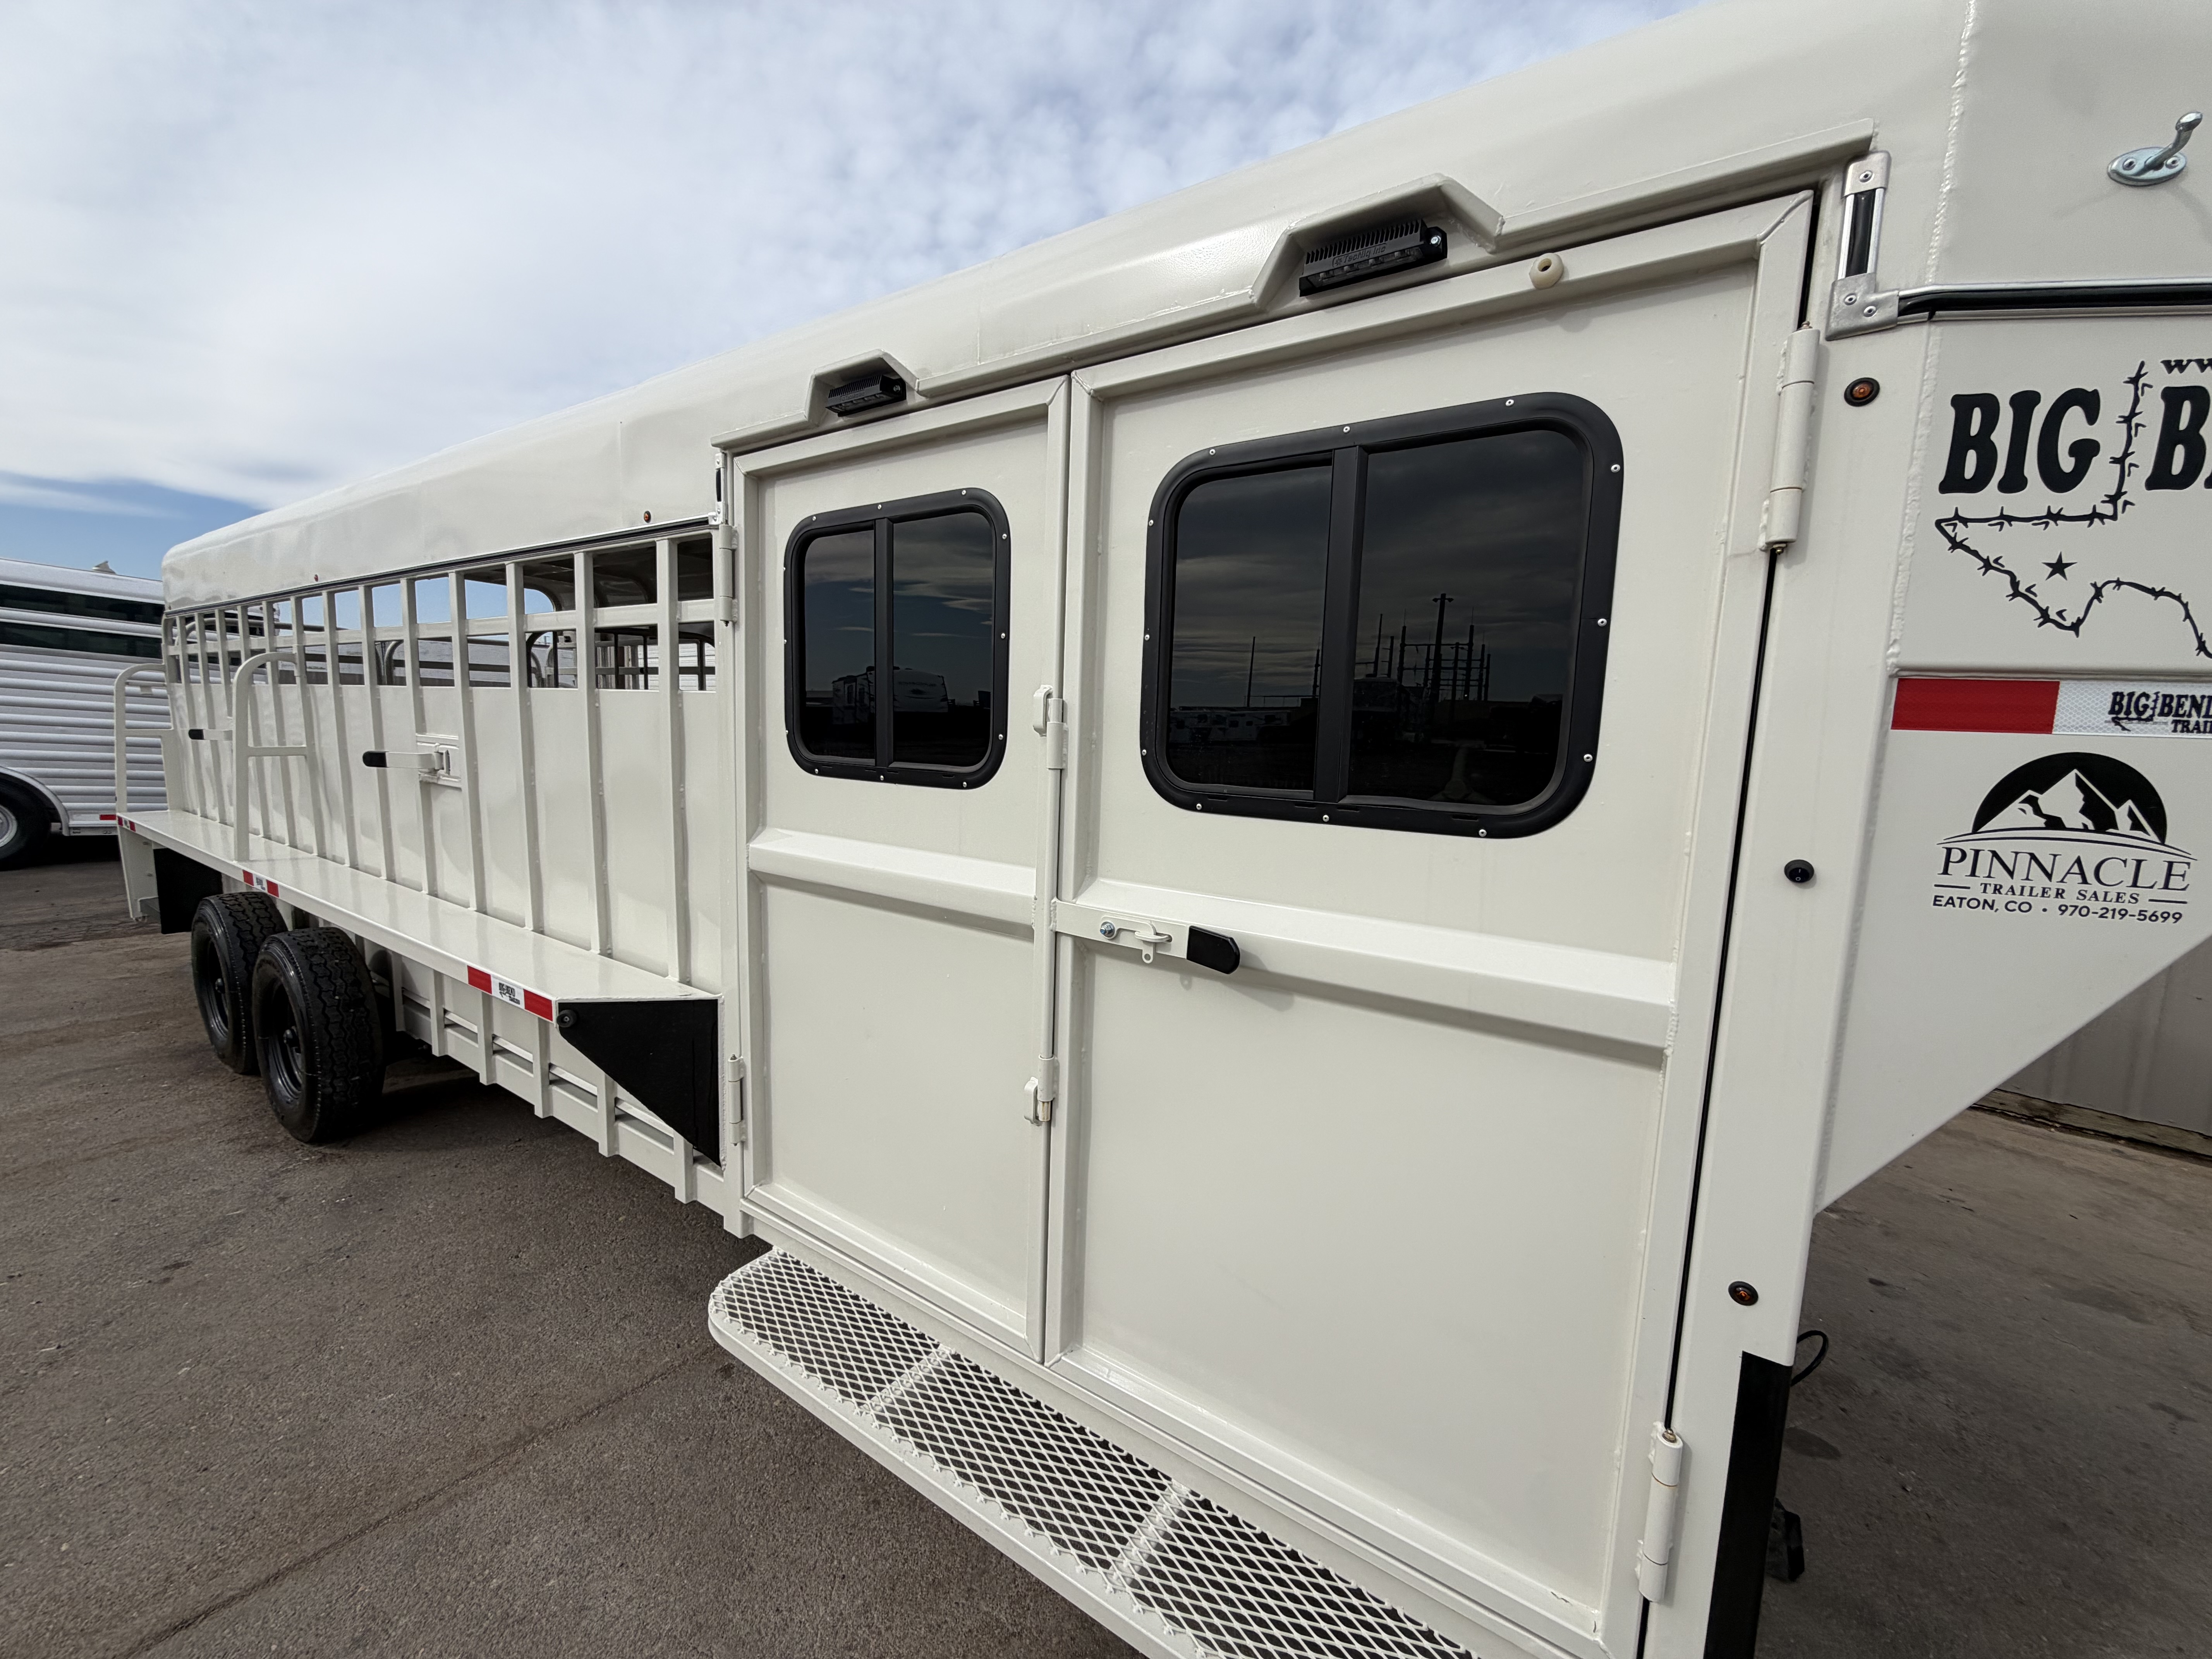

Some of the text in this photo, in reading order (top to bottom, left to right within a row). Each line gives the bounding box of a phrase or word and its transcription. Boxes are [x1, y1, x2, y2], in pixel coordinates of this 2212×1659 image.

[1938, 386, 2212, 494] BIG B
[2108, 691, 2151, 717] BIG
[2171, 720, 2212, 734] TRAI
[1937, 847, 2191, 891] PINNACLE
[1980, 883, 2140, 904] TRAILER SALES
[1932, 895, 2183, 924] EATON, CO 970-219-5699
